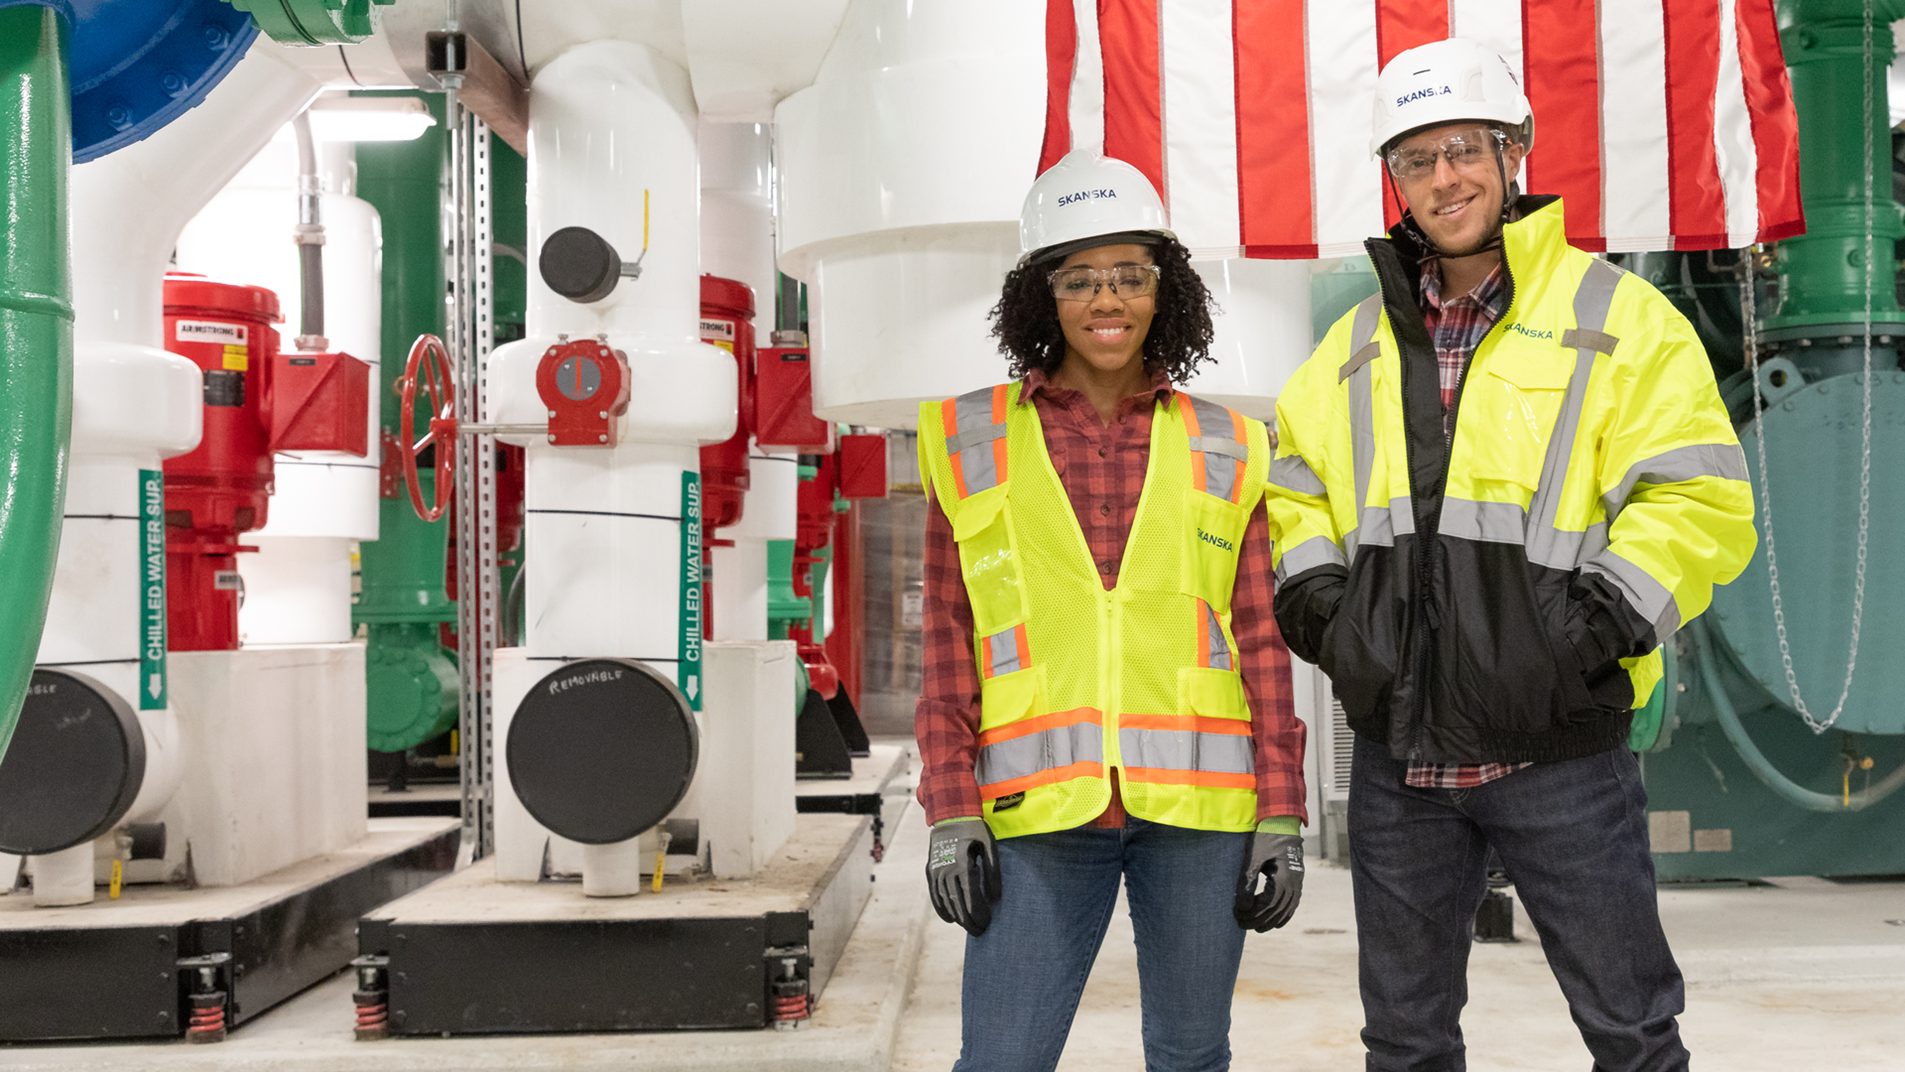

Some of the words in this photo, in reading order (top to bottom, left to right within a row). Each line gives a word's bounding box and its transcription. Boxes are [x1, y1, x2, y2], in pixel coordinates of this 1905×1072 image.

[1057, 188, 1117, 207] SKANSKA
[699, 321, 725, 332] STRONG
[145, 479, 161, 516] SUP.
[687, 481, 700, 518] SUP.
[146, 520, 162, 582] WATER
[686, 522, 700, 583] WATER
[147, 585, 163, 661] CHILLED
[685, 587, 700, 662] CHILLED
[548, 669, 623, 695] REMOVABLE
